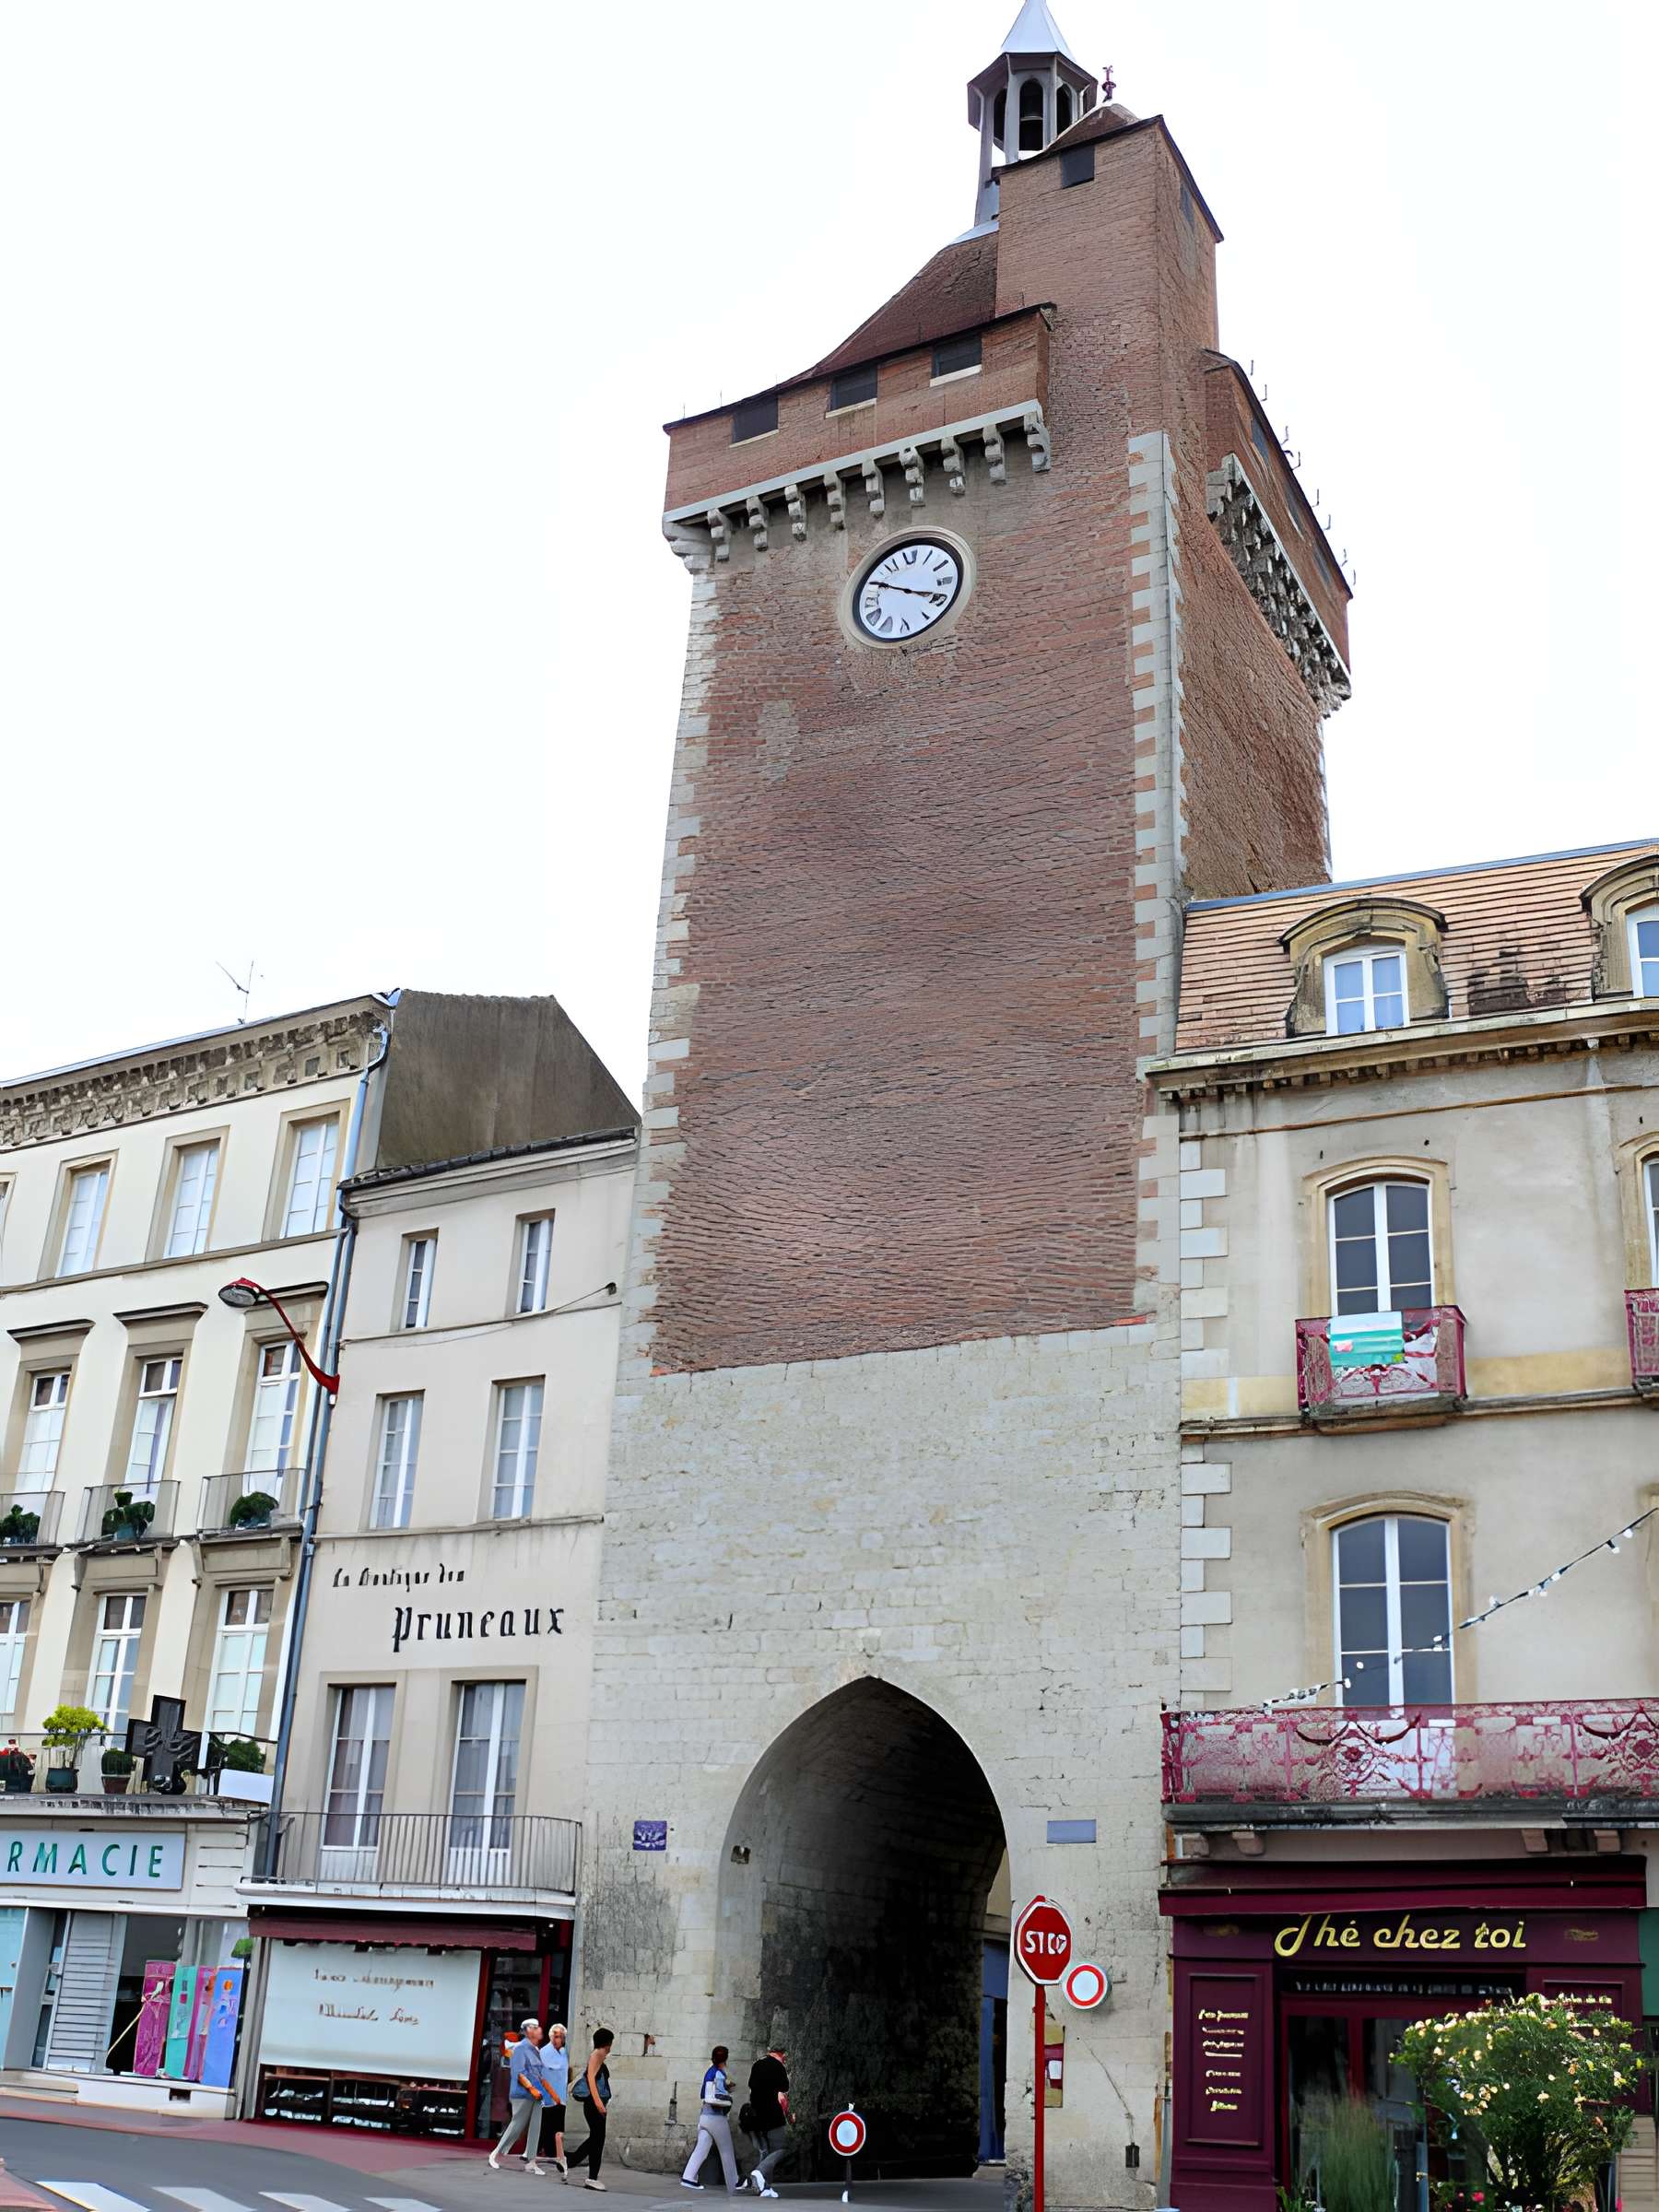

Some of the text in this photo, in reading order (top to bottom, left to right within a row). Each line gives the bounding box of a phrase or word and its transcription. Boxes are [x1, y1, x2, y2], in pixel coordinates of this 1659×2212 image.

[392, 1606, 564, 1653] Pruneaux
[7, 1841, 163, 1878] RMACIE
[1025, 1930, 1067, 1955] STOP
[1274, 1913, 1360, 1957] Thé
[1373, 1913, 1460, 1948] chez
[1474, 1921, 1526, 1948] toi
